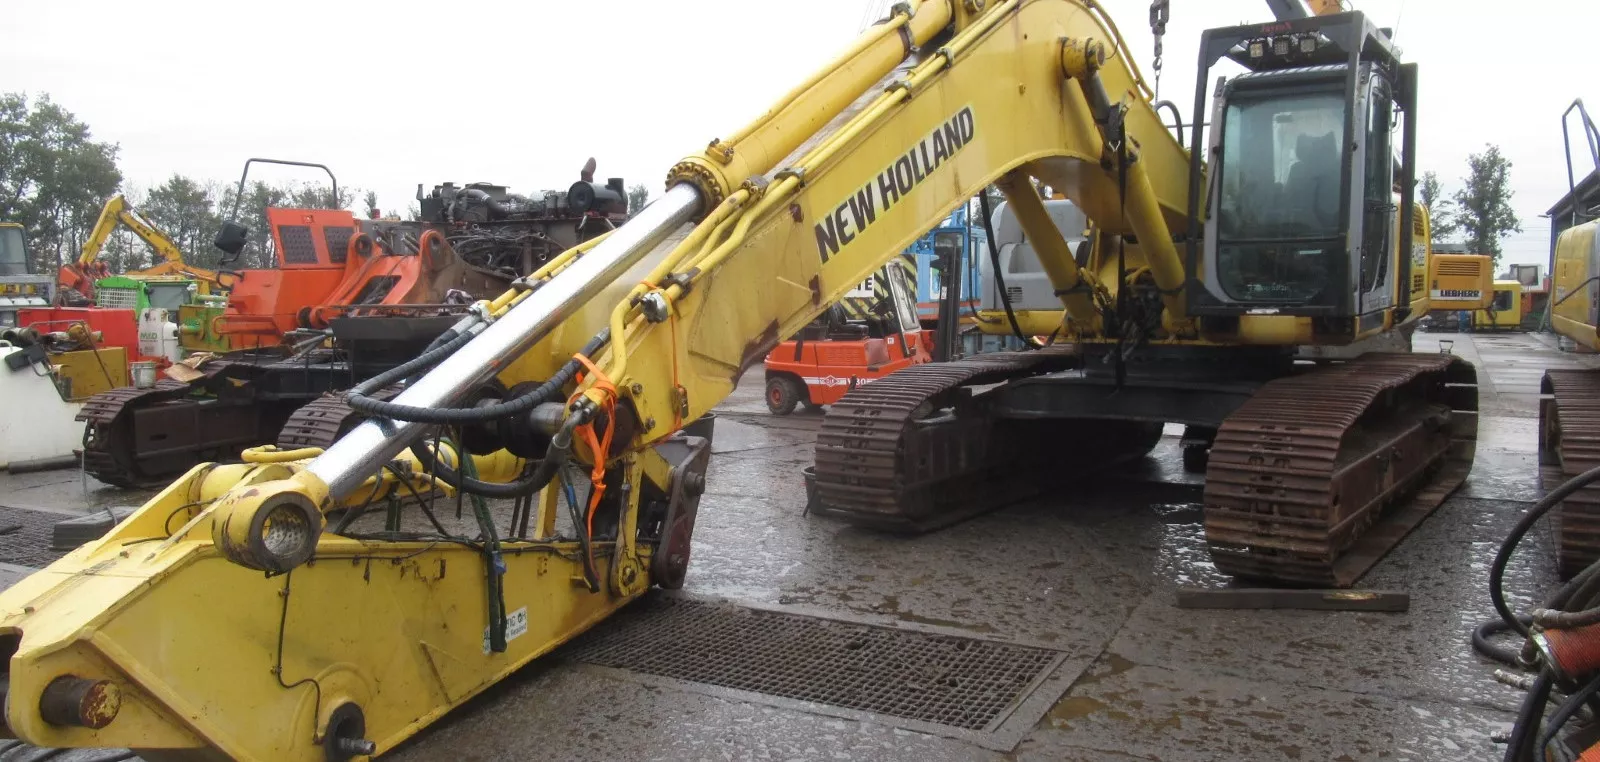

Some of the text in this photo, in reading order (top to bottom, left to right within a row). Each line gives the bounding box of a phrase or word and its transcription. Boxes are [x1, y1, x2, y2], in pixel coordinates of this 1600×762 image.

[814, 106, 974, 264] NEW HOLLAND
[1440, 289, 1480, 298] LIEBHERR
